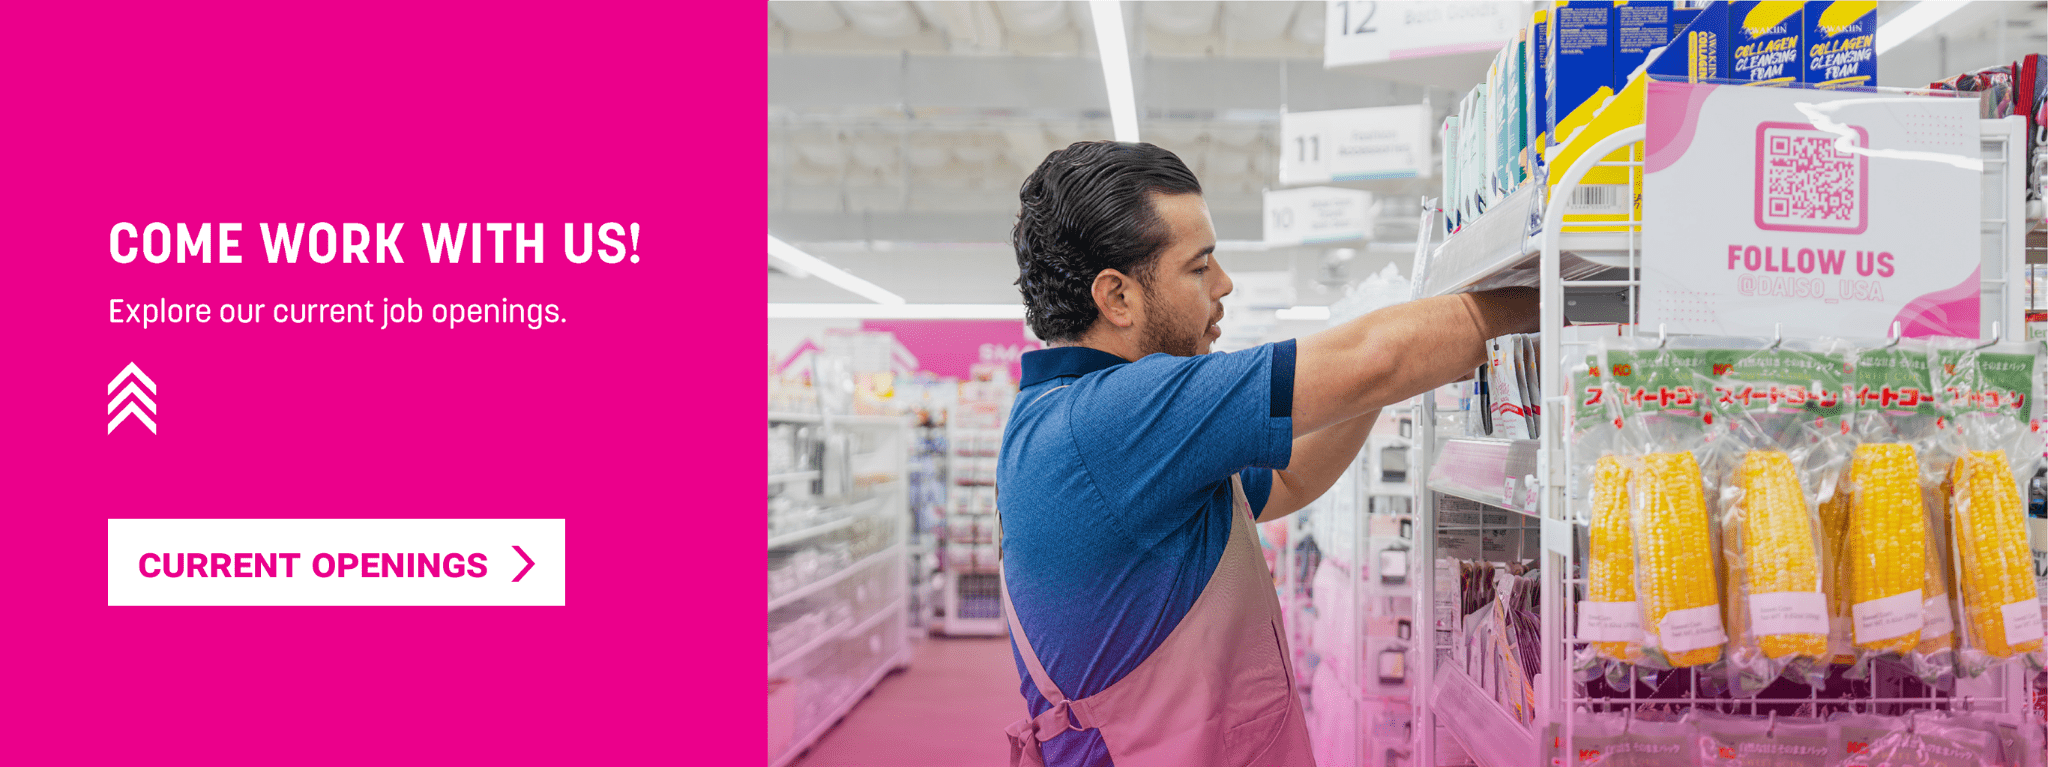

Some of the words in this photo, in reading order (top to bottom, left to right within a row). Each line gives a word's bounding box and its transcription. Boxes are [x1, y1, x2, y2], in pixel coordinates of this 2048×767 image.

[1335, 0, 1377, 35] 12
[1698, 31, 1708, 80] COLLAGEN
[1734, 35, 1798, 58] COLLAGEN
[1809, 34, 1874, 57] COLLAGEN
[1735, 49, 1797, 72] CLEANSING
[1810, 48, 1872, 71] CLEANSING
[1749, 64, 1784, 81] FOAM
[1825, 63, 1858, 80] FOAM
[1295, 134, 1321, 162] 11
[1272, 206, 1294, 229] 10
[1728, 244, 1846, 275] FOLLOW
[1856, 250, 1895, 278] US
[1737, 273, 1884, 304] @DAISO_USA
[1713, 385, 1839, 408] スイートコーン
